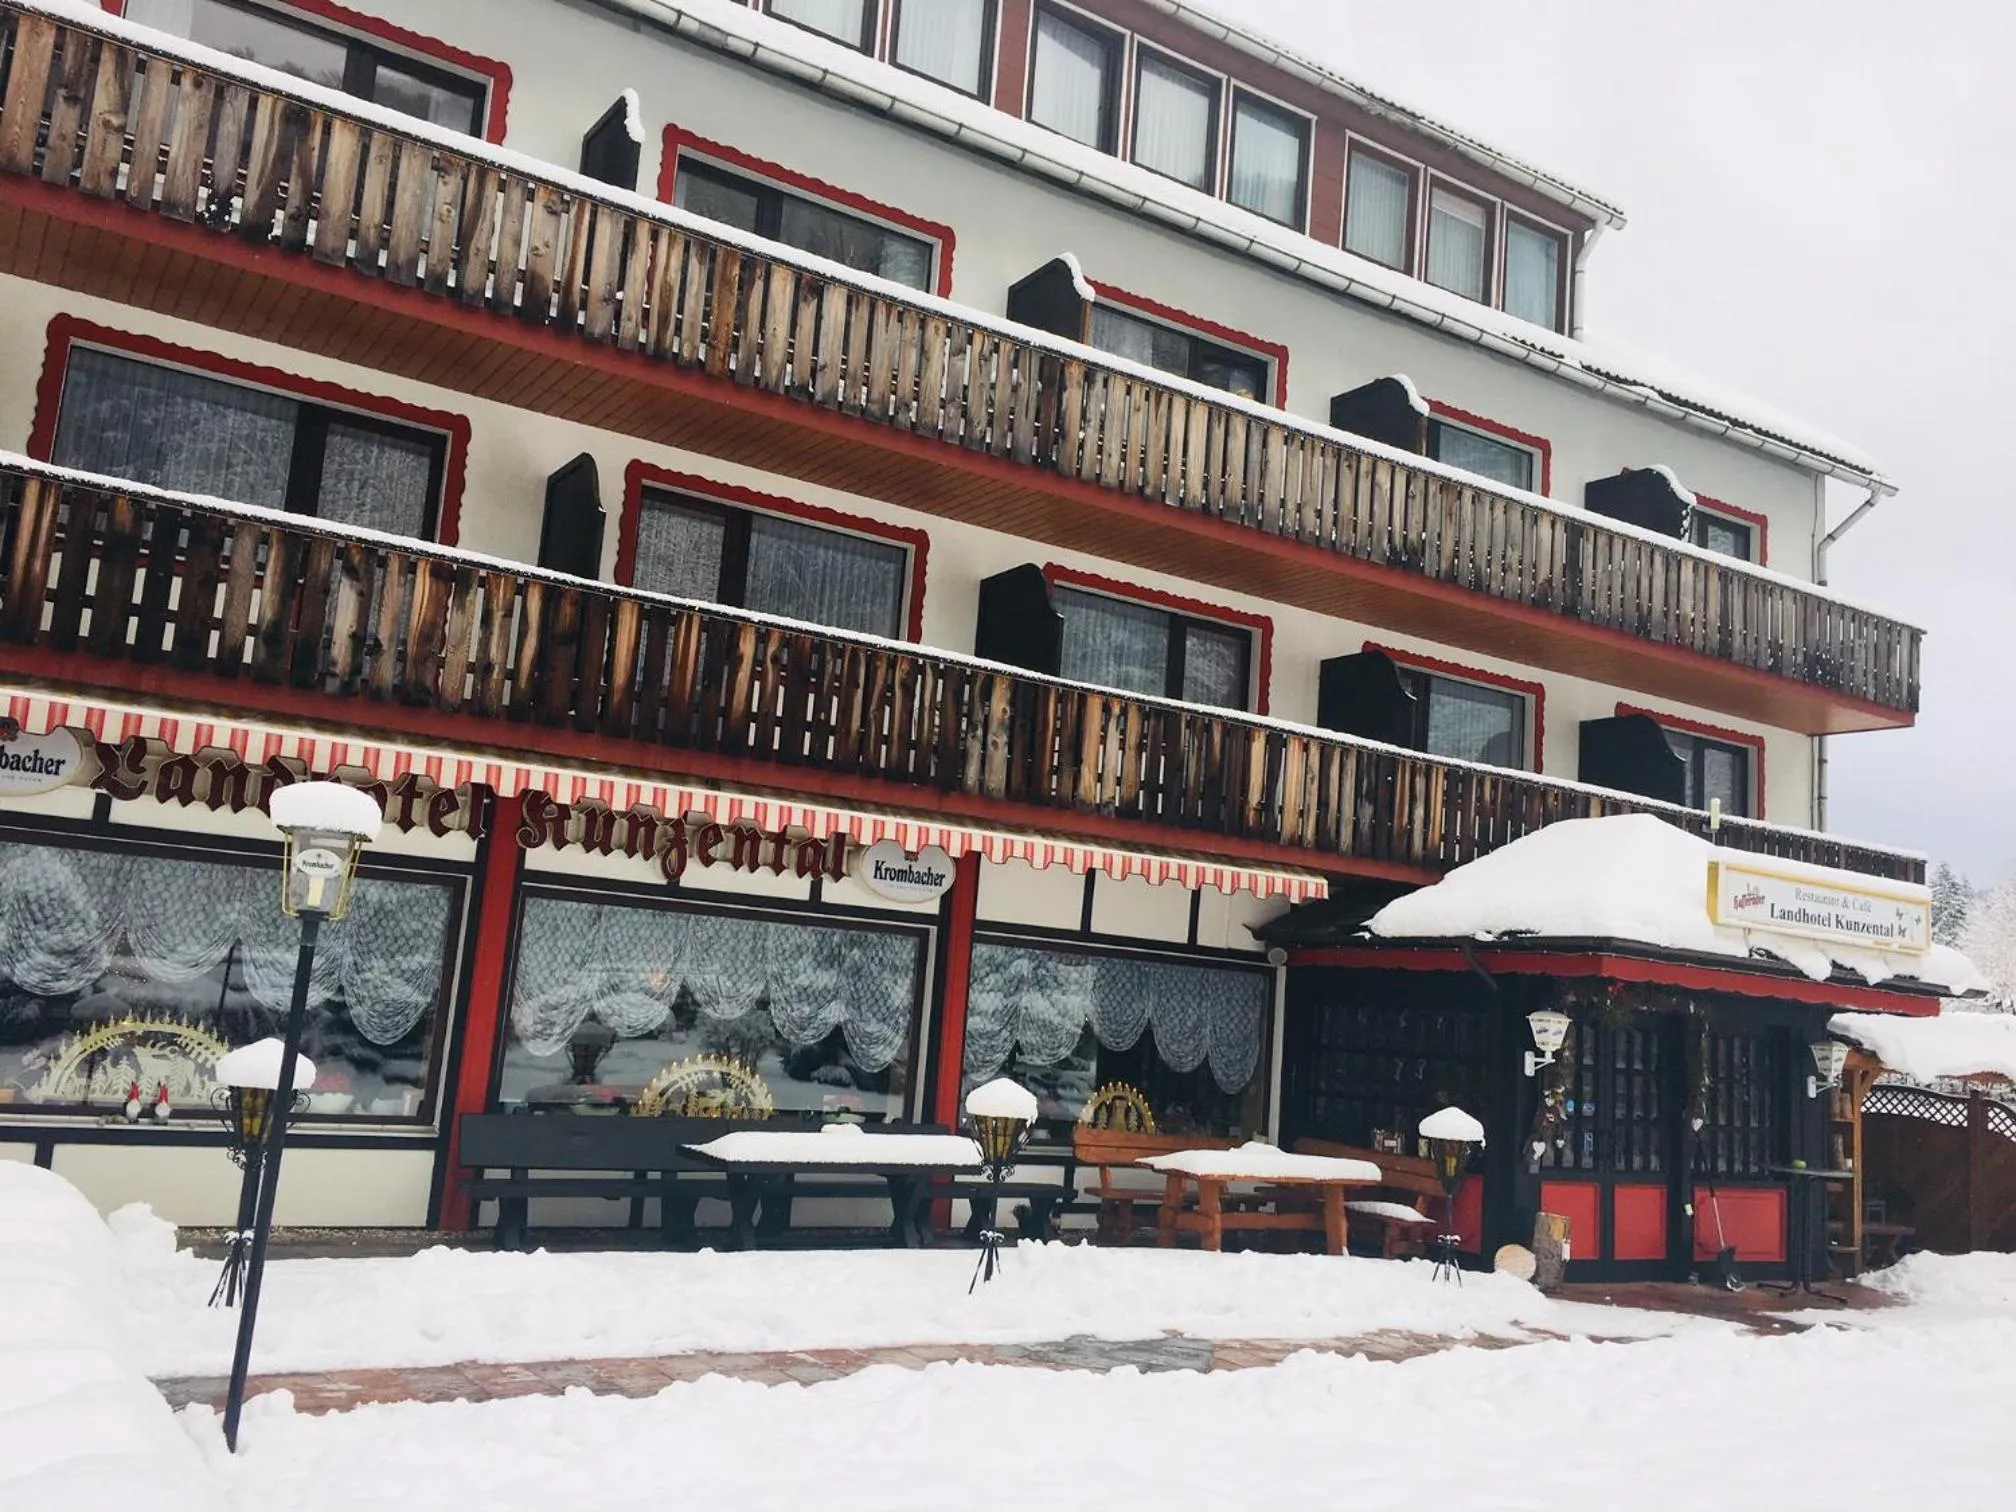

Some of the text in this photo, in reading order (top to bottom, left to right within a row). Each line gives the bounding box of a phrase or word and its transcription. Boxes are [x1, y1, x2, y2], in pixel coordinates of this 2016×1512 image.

[89, 734, 856, 884] Landtel Kunzental
[873, 859, 946, 887] Krombacher
[1770, 902, 1894, 938] Landhotel Kunzental
